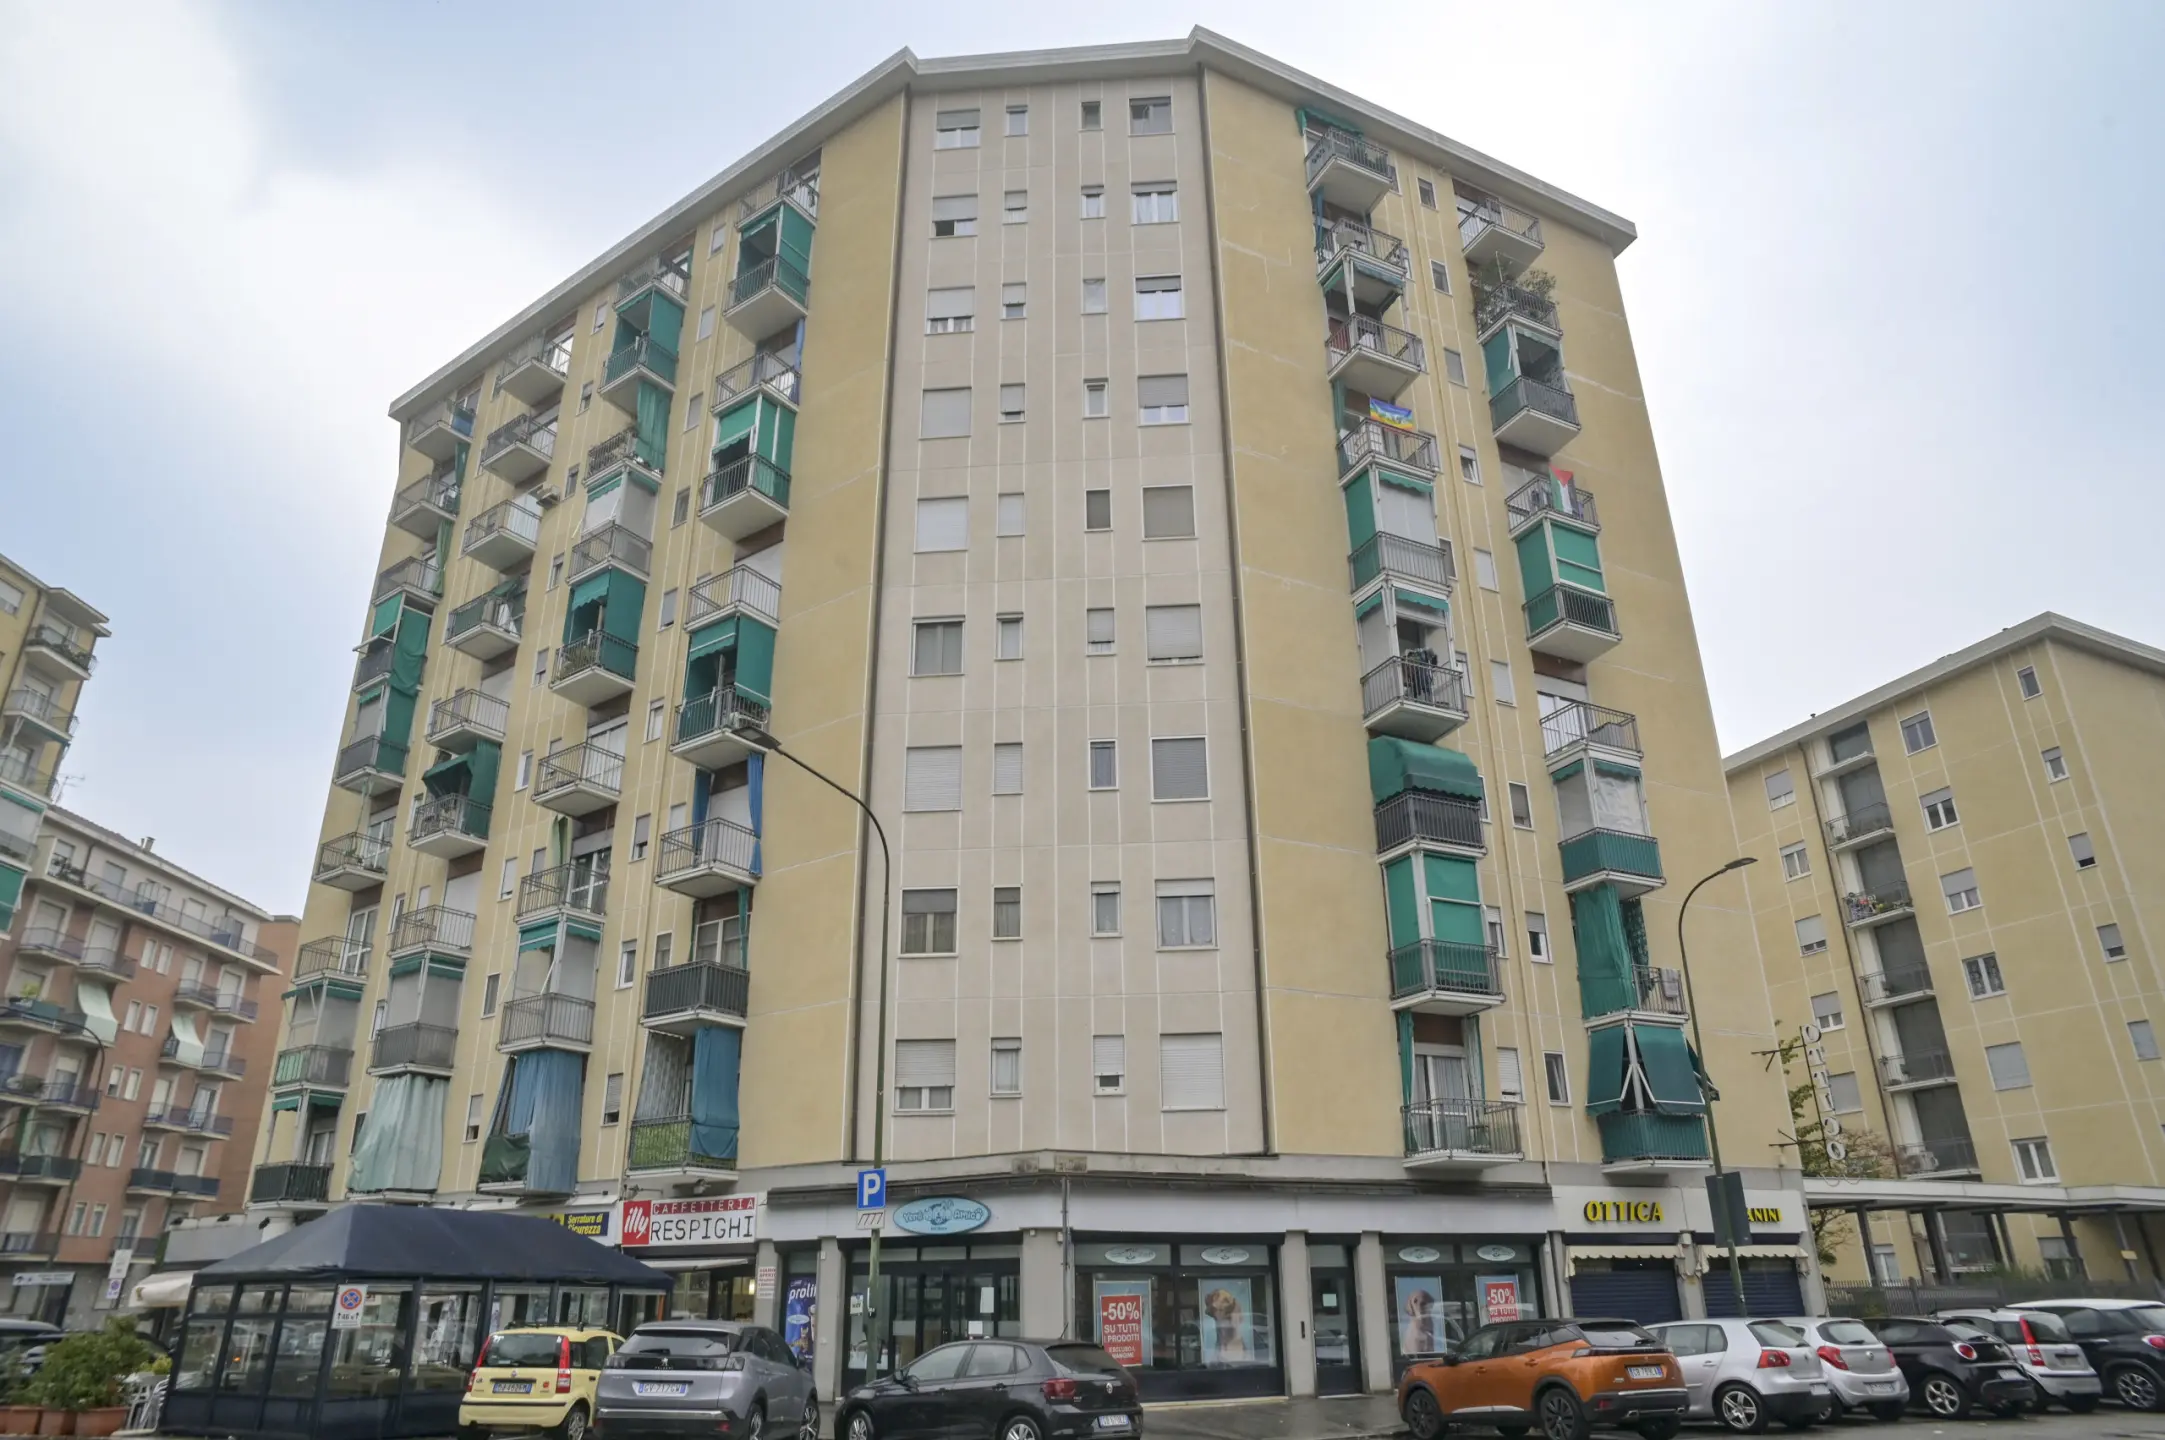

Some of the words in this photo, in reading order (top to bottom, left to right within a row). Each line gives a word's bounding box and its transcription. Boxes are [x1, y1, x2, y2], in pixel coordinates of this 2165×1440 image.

[863, 1173, 881, 1206] P
[653, 1199, 754, 1214] CAFFETTERIA
[1584, 1200, 1664, 1222] OTTICA
[568, 1214, 595, 1224] Serrature
[596, 1212, 604, 1223] di
[624, 1206, 650, 1239] illy
[650, 1215, 754, 1241] RESPIGHI
[1487, 1288, 1515, 1304] -50%
[1102, 1301, 1140, 1320] -50%
[1104, 1324, 1116, 1333] SU
[1116, 1323, 1139, 1333] TUTTI
[1107, 1334, 1140, 1343] PRODOTTI
